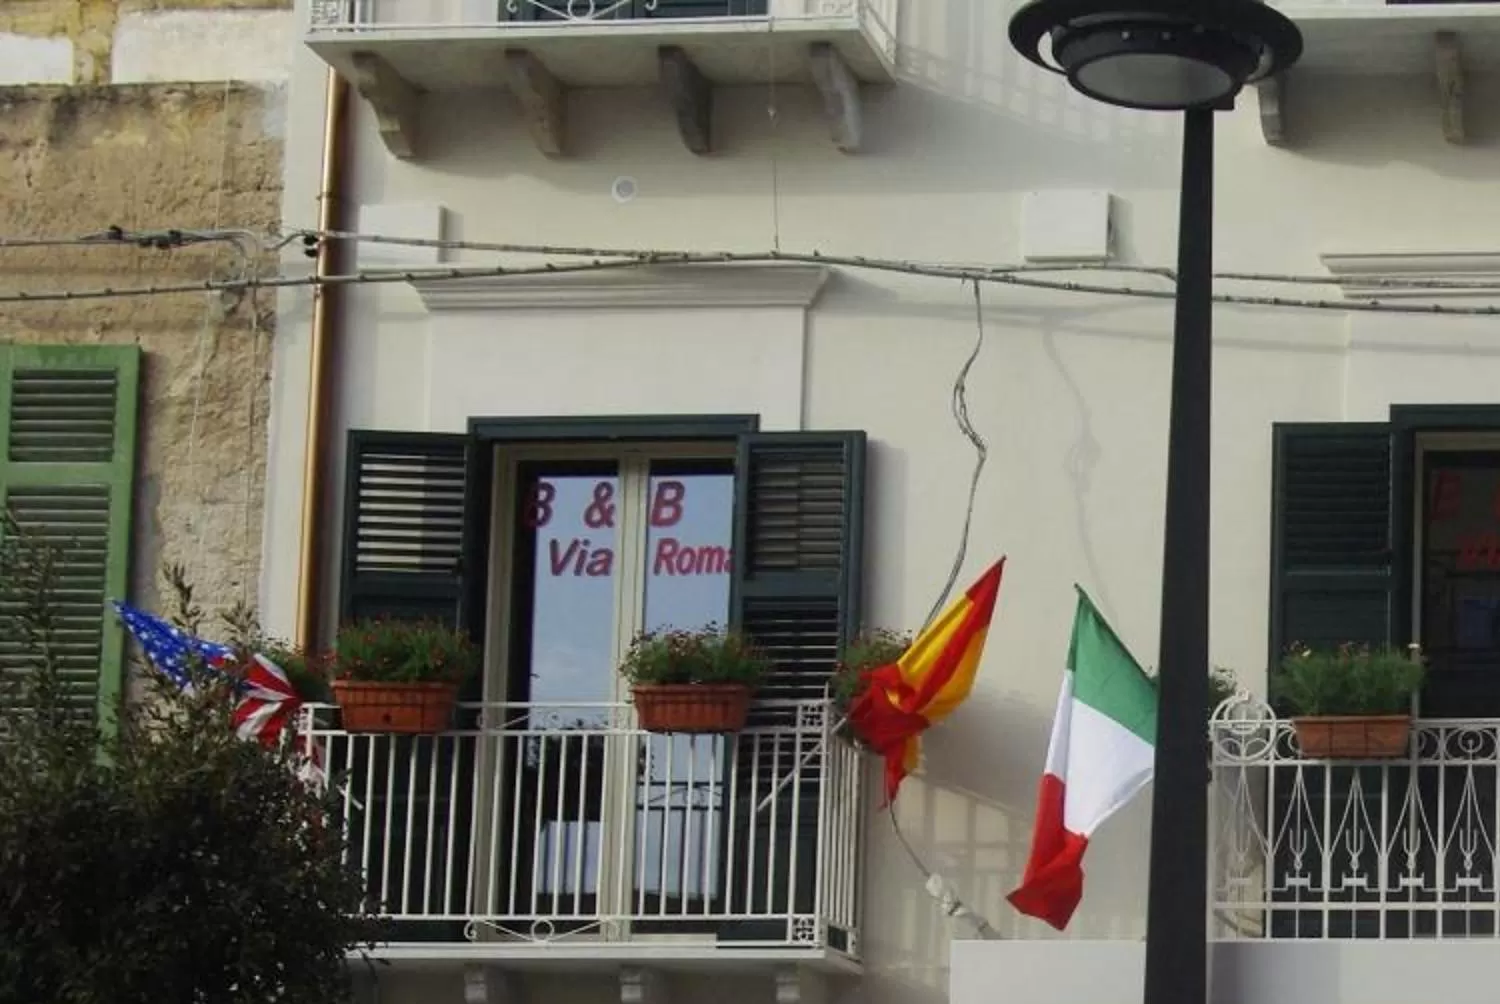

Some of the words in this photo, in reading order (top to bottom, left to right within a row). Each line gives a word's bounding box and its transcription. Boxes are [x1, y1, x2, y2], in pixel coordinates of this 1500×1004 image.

[525, 480, 556, 529] B
[584, 480, 616, 529] &
[650, 480, 686, 528] B
[549, 538, 615, 577] Via
